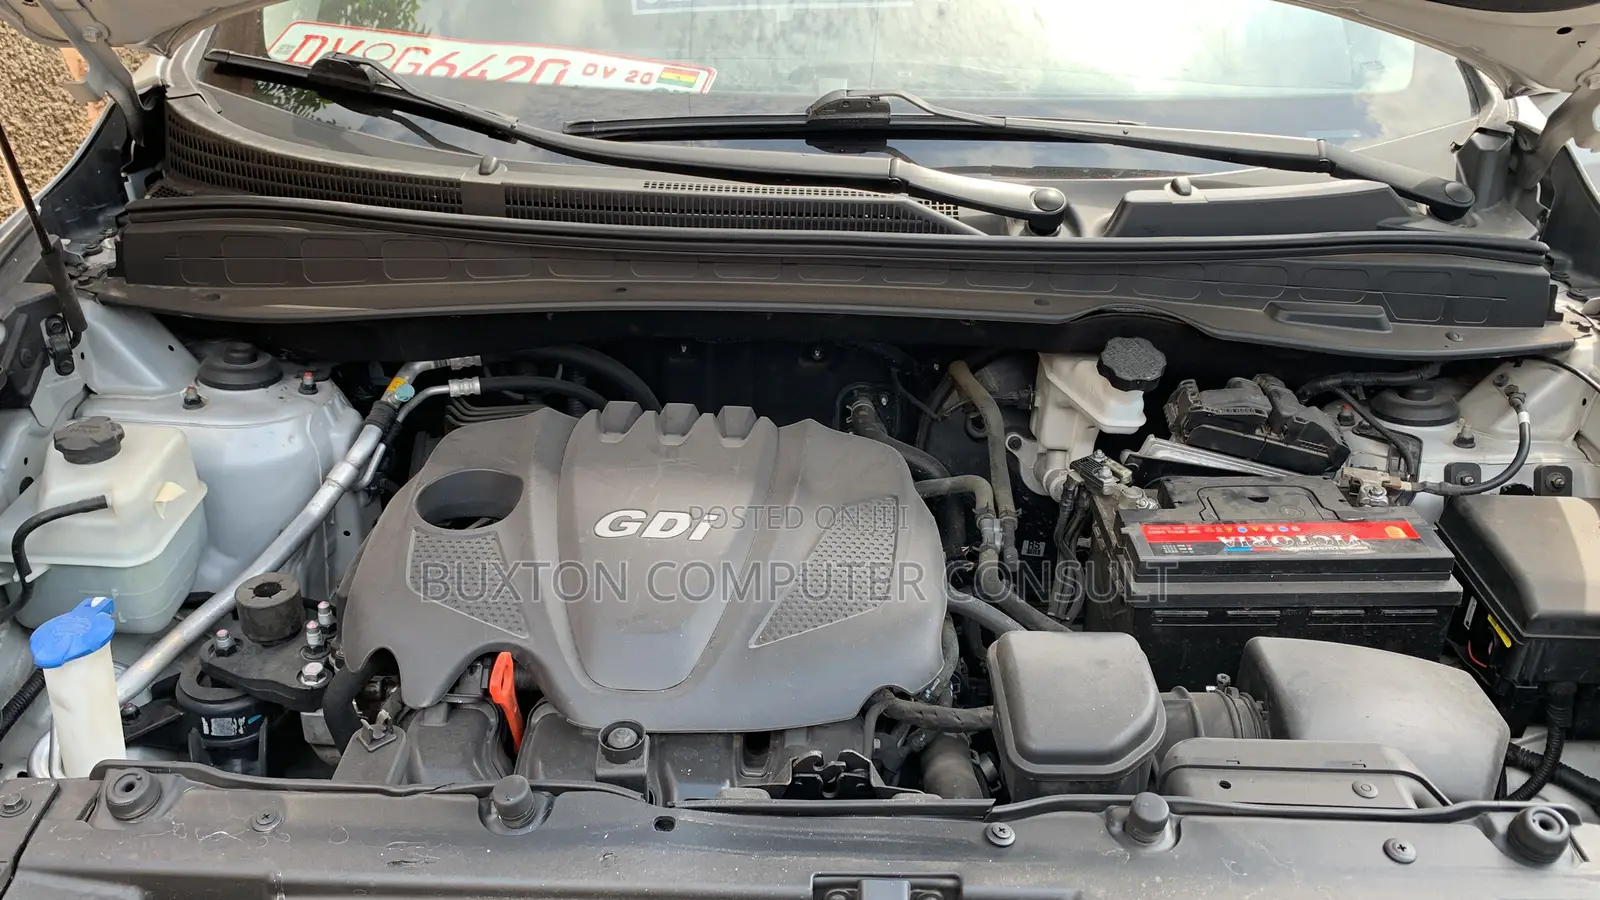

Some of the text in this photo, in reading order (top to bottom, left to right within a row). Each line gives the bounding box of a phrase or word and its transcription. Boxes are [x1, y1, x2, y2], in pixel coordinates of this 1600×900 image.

[582, 63, 655, 85] DV 20
[1216, 534, 1366, 548] VICTORIA
